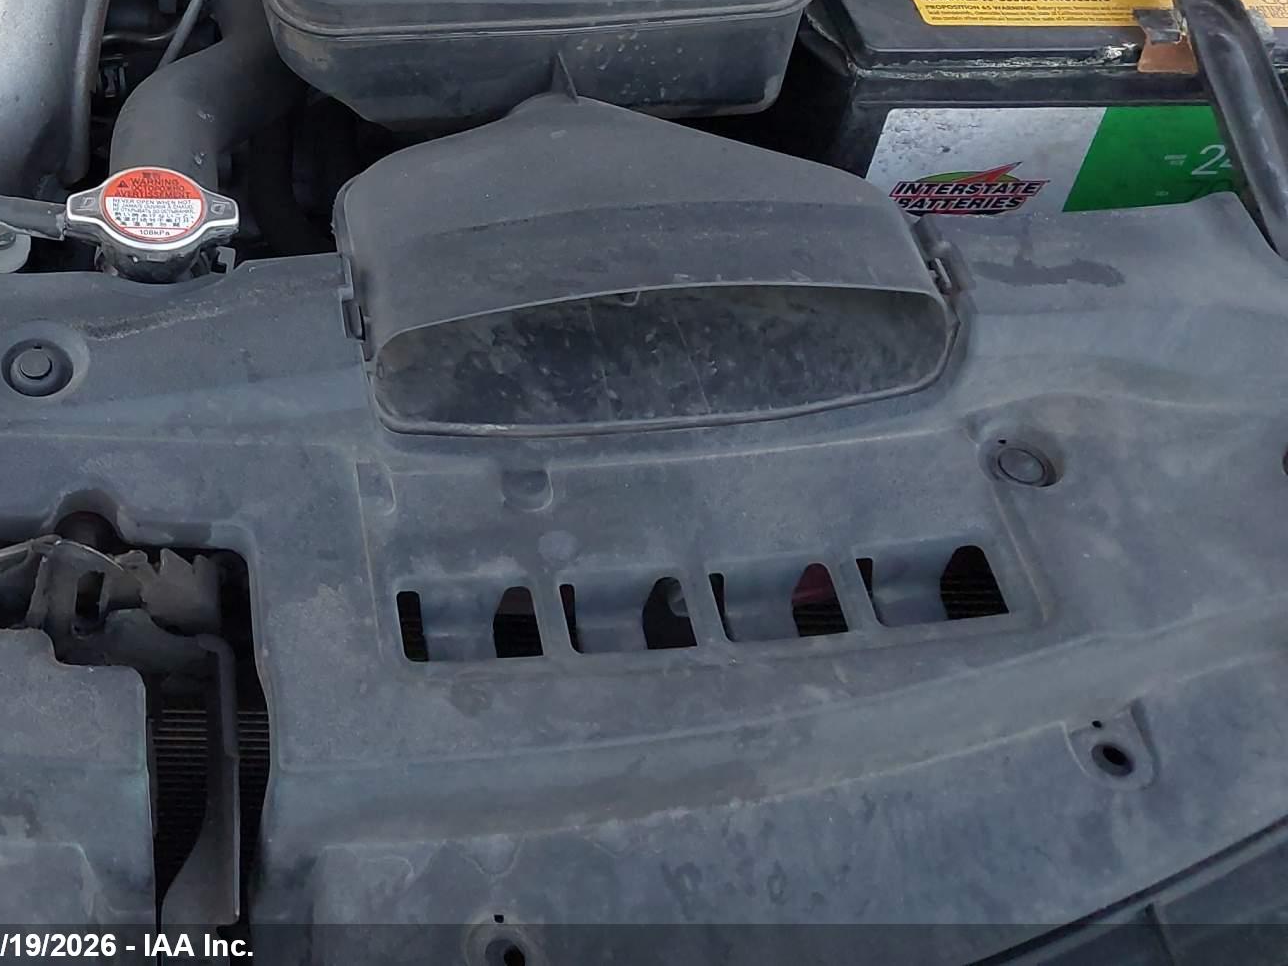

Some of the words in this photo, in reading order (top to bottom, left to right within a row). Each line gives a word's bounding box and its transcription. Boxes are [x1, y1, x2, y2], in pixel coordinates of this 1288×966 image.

[131, 178, 179, 187] WARNING
[115, 190, 191, 199] AVERTISSEMENT
[895, 182, 1038, 196] INTERSTATE
[896, 196, 1025, 210] BATTERIES
